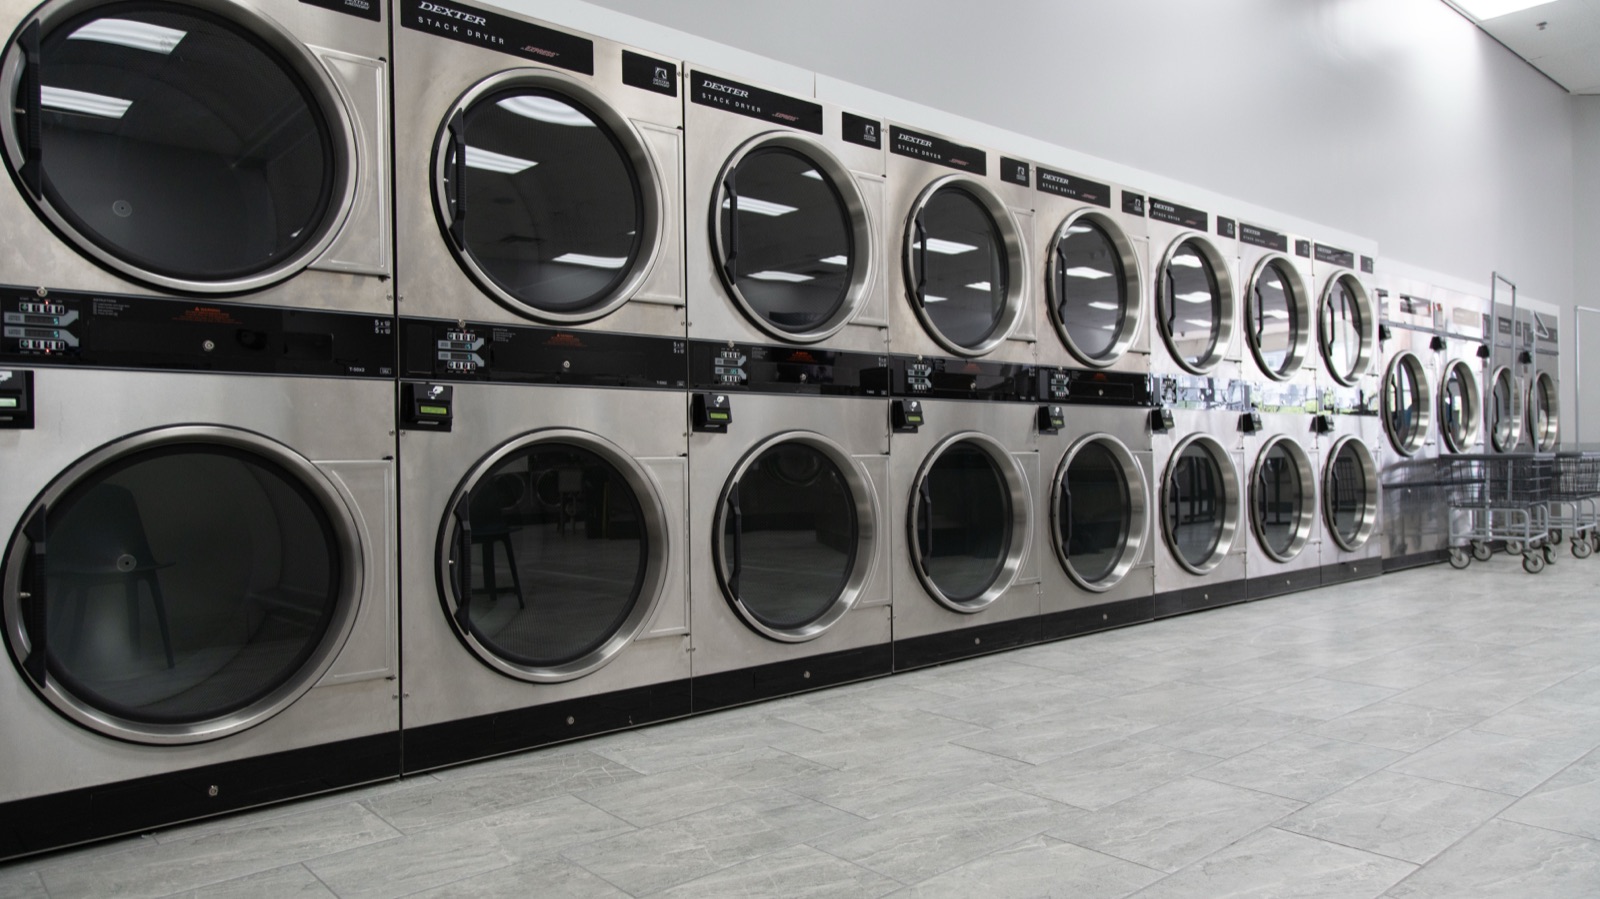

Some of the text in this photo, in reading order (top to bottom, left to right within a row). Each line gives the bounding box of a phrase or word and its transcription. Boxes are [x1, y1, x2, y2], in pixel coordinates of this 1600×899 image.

[418, 1, 486, 26] DEXTER
[418, 16, 504, 45] STACK DRYER
[702, 80, 749, 98] DEXTER
[702, 92, 761, 112] STACK DRYER
[898, 133, 932, 147] DEXTER
[898, 144, 942, 159] STACK DRYER
[1042, 173, 1069, 185] DEXTER
